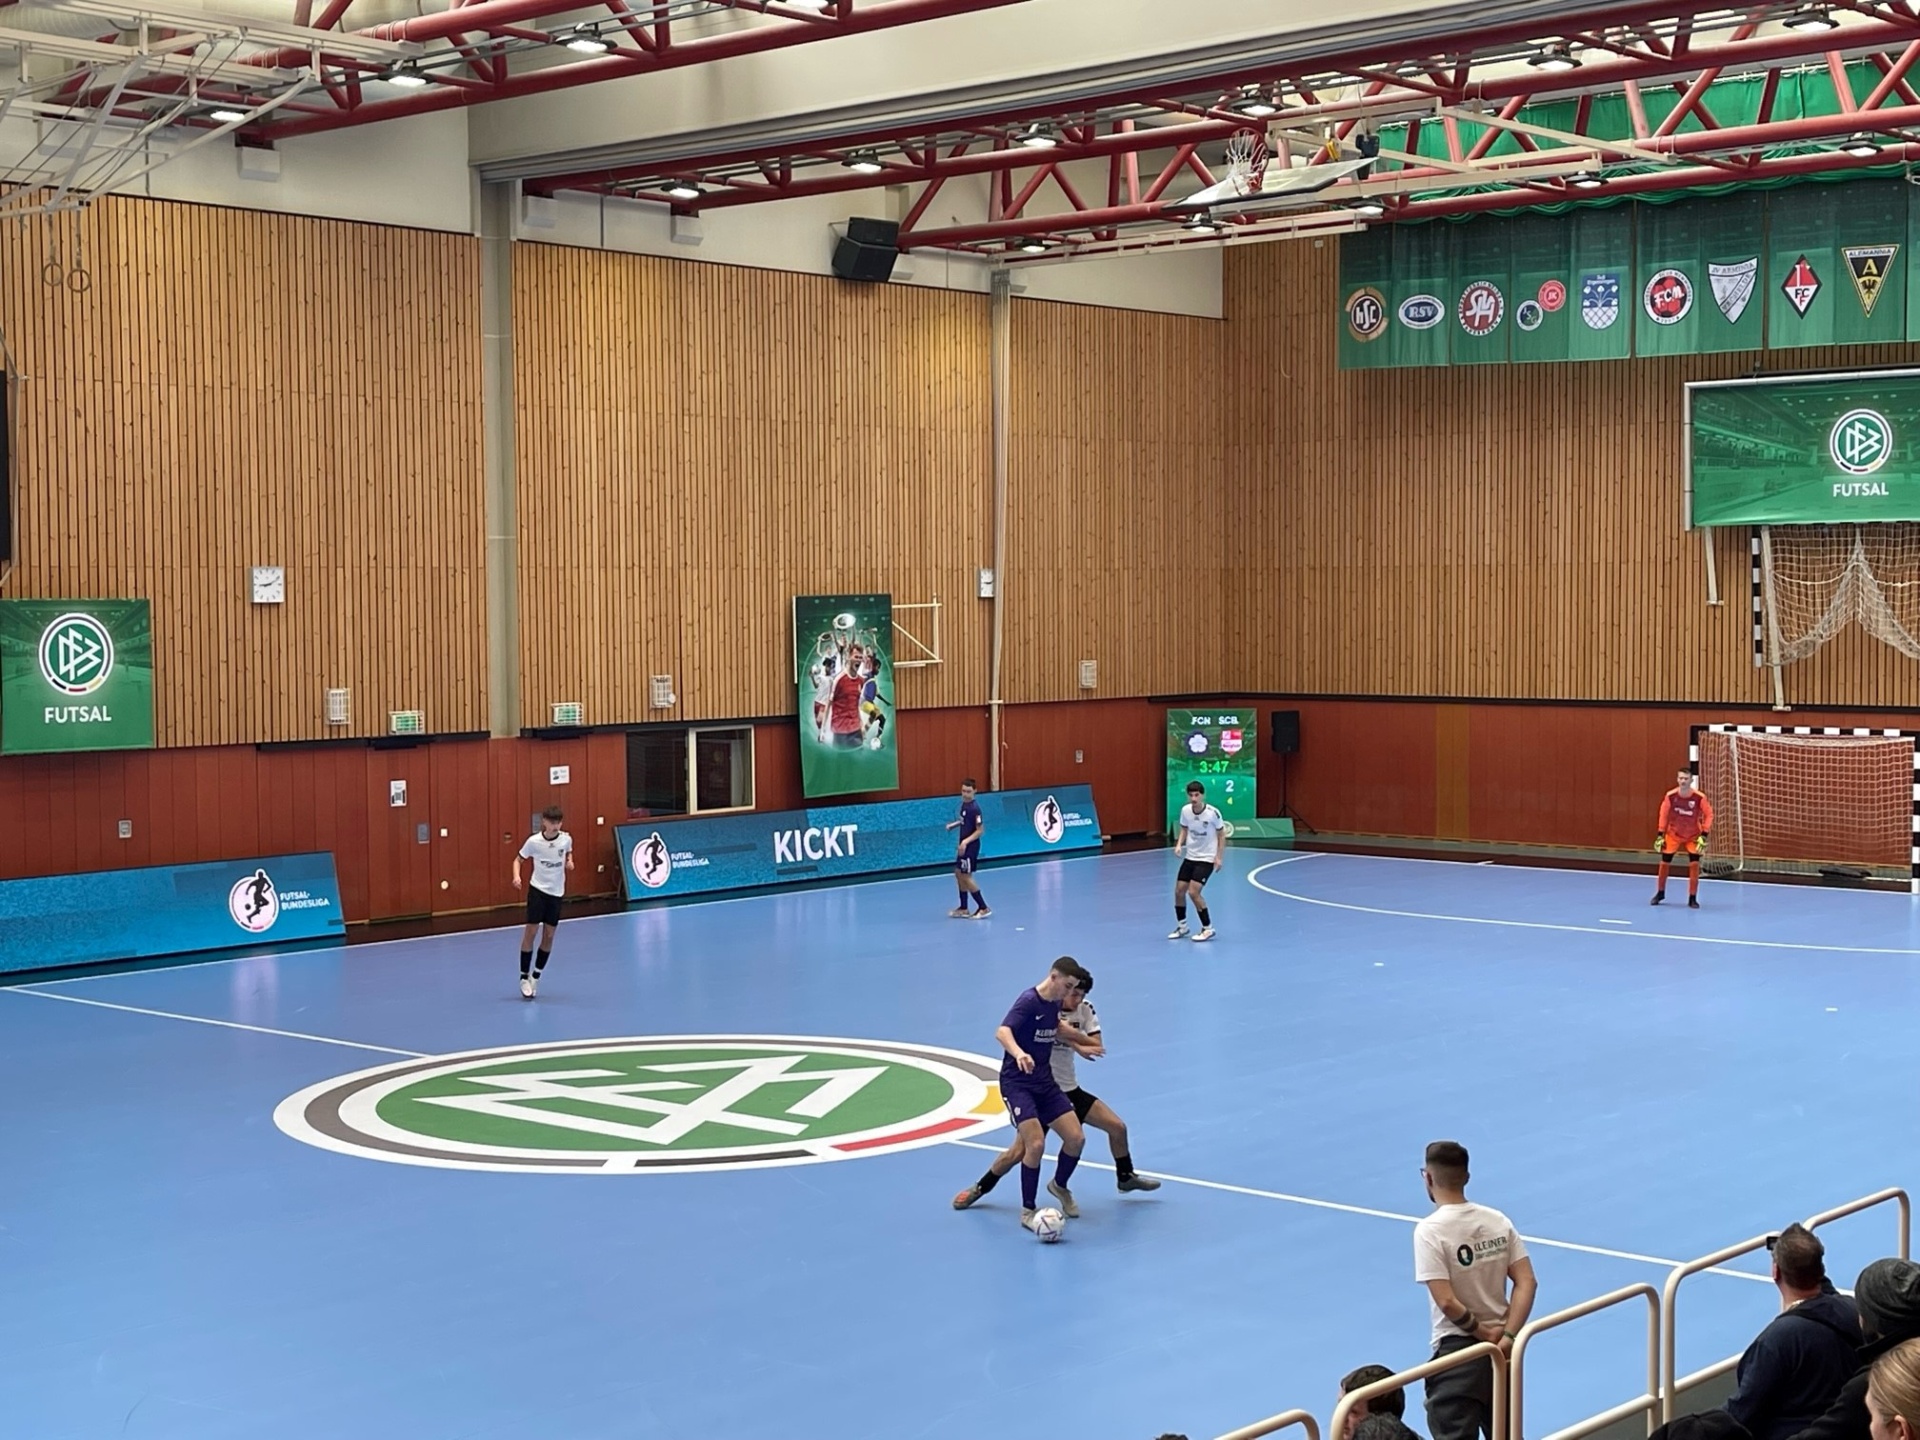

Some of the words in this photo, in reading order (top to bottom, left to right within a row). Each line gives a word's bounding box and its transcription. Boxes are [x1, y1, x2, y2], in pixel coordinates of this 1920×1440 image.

[1848, 248, 1892, 257] ALEMANNIA
[1408, 305, 1435, 319] RSV
[1832, 482, 1890, 498] FUTSAL
[44, 705, 112, 724] FUTSAL
[1200, 761, 1229, 773] 3:47
[1225, 780, 1235, 792] 2
[773, 824, 858, 864] KICKT
[672, 858, 710, 869] BUNDESLIGA
[280, 890, 311, 901] FUTSAL-
[281, 898, 330, 911] BUNDESLIGA
